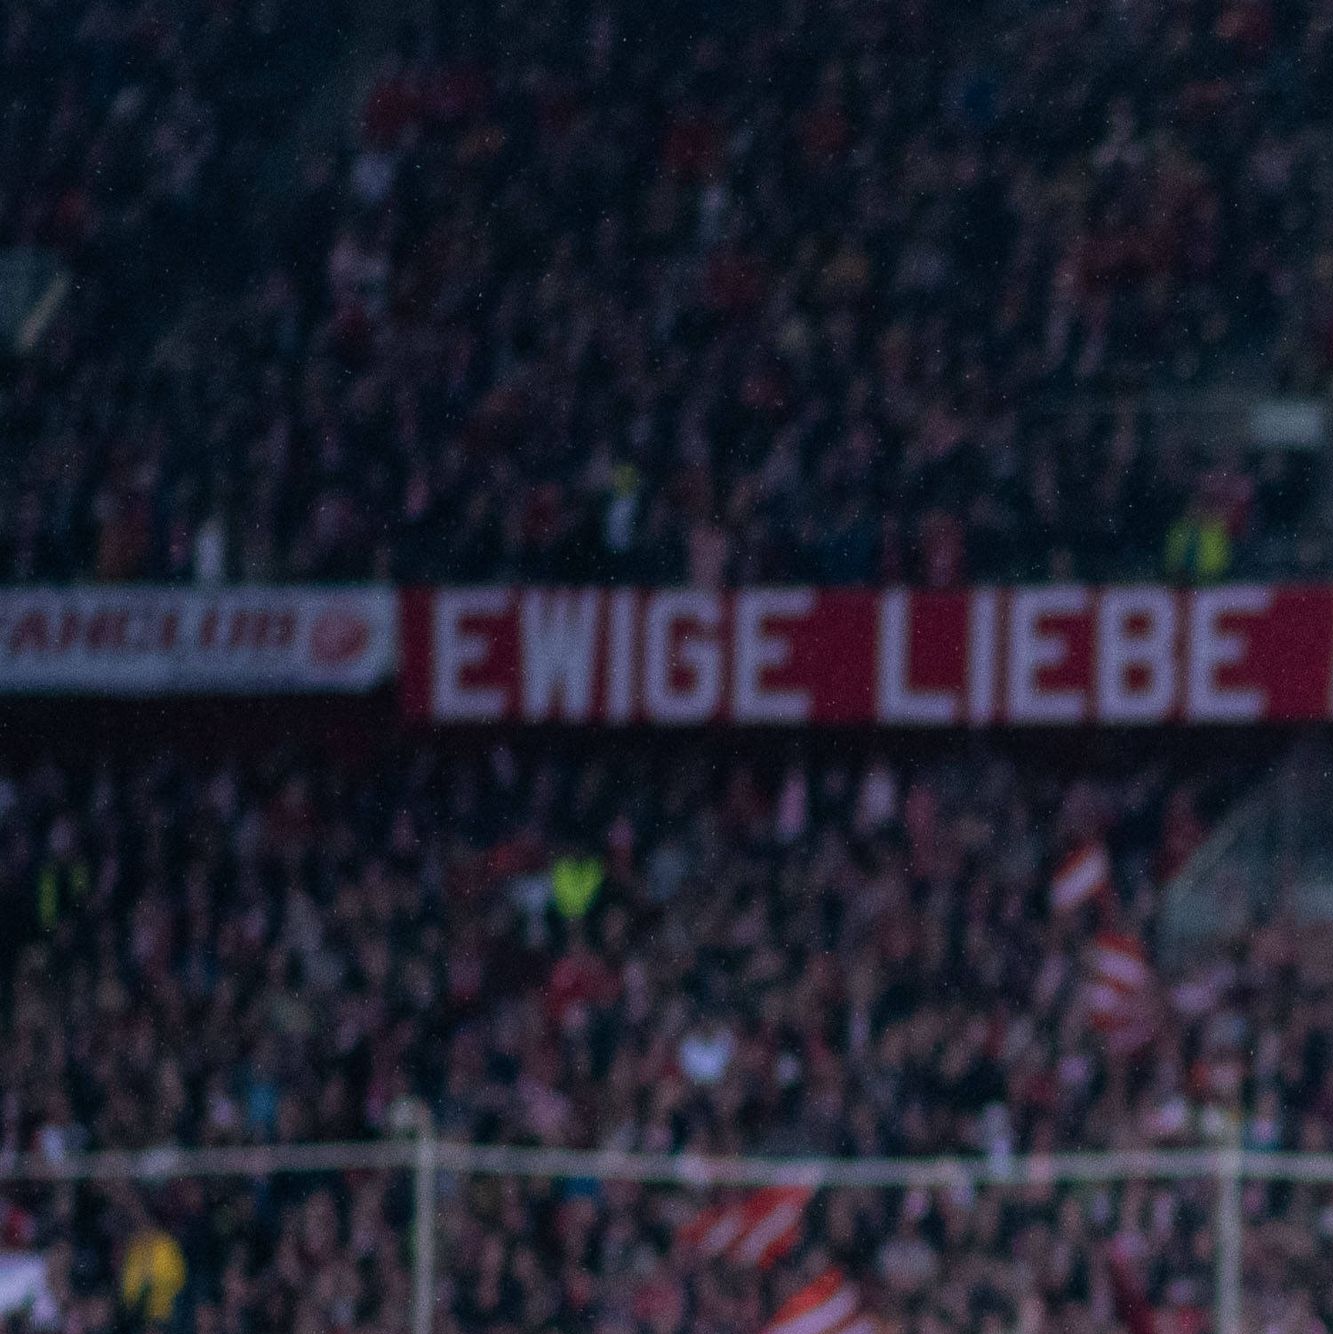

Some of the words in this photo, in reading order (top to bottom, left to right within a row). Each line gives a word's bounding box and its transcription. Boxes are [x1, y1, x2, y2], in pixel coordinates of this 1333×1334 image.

[0, 607, 298, 655] ANCLUB
[430, 588, 812, 720] EWIGE
[878, 586, 1272, 721] LIEBE
